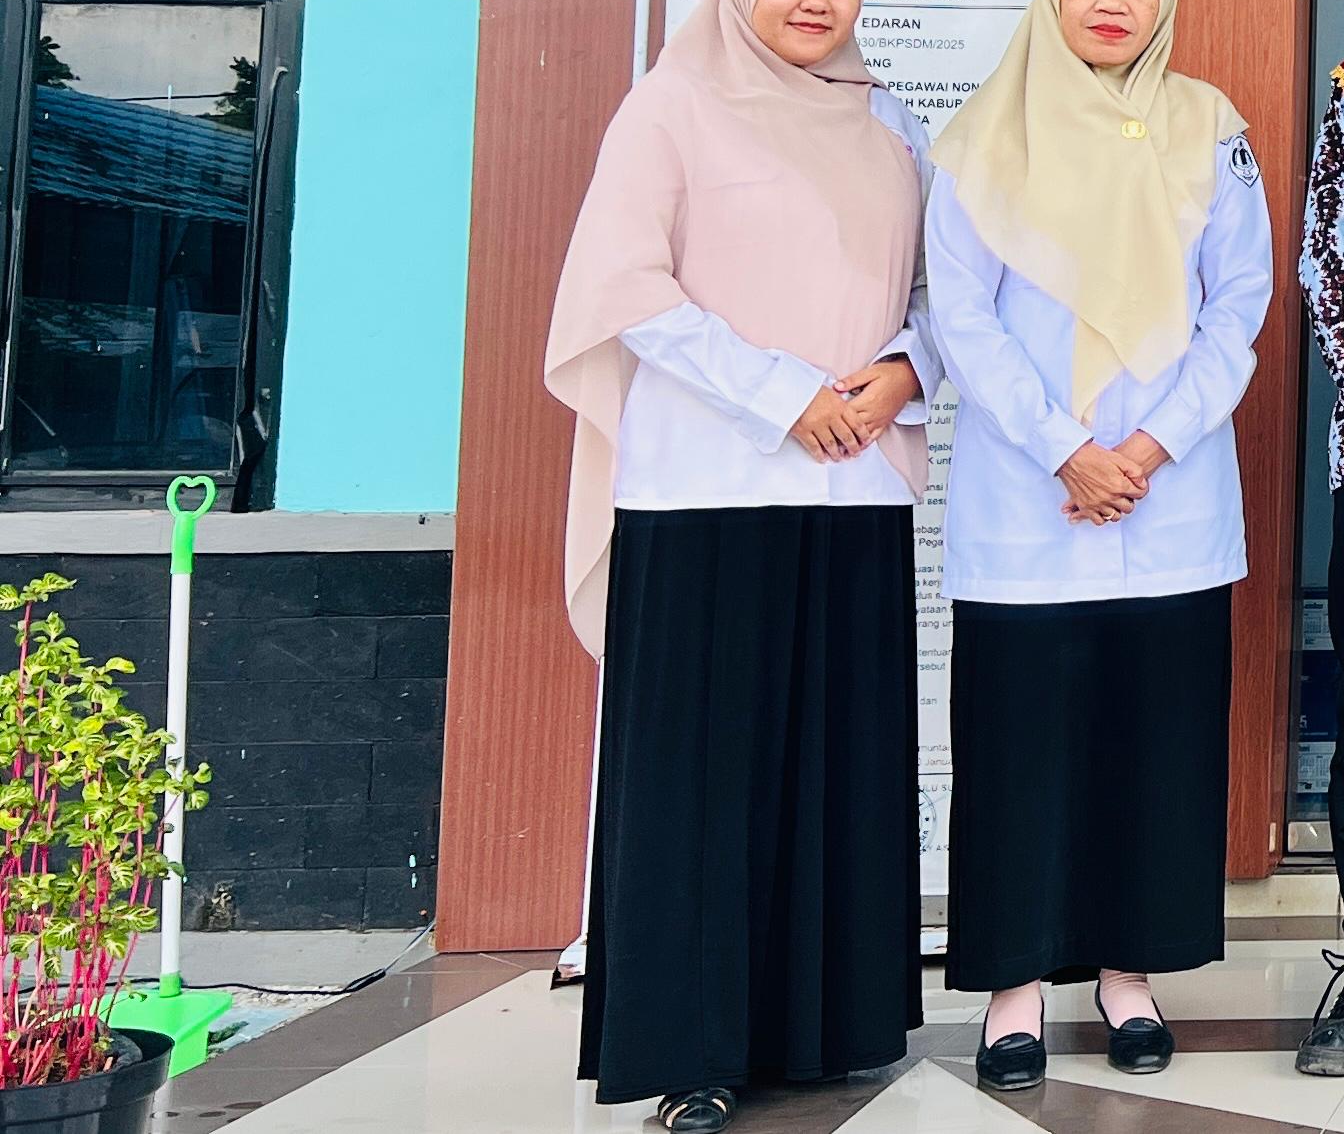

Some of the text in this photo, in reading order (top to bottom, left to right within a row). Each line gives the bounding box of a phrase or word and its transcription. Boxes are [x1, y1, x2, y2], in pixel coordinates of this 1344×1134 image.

[861, 17, 922, 30] EDARAN
[888, 81, 949, 92] PEGAWAI
[918, 98, 963, 109] KABUP
